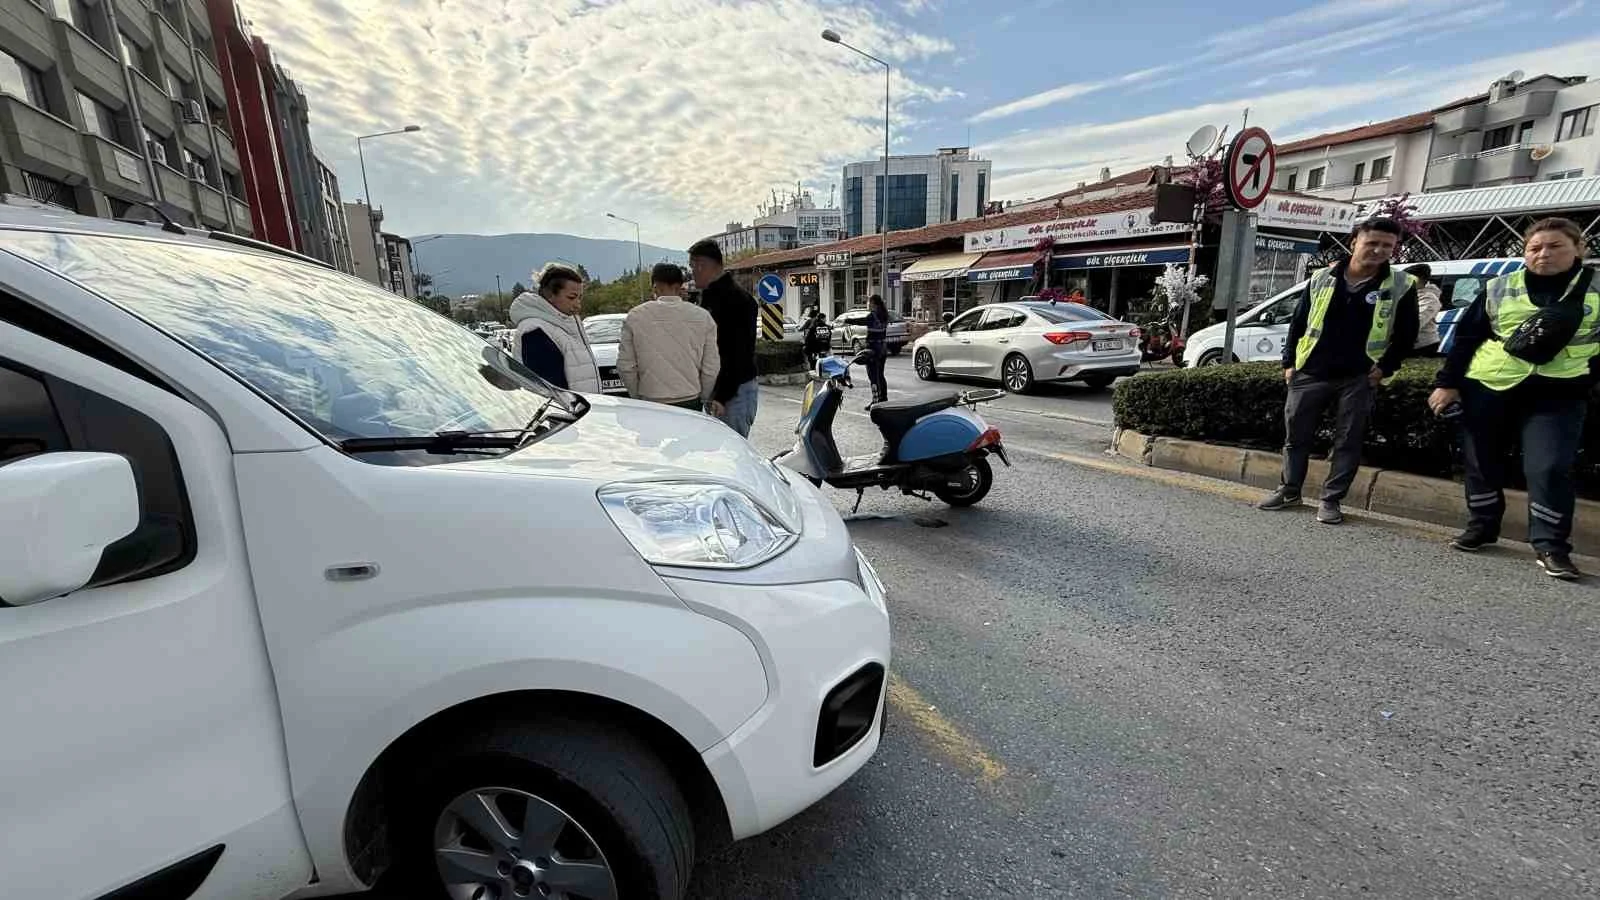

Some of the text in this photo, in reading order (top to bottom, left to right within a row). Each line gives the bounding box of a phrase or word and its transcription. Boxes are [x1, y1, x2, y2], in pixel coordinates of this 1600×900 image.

[1028, 224, 1044, 234] GÜL
[1086, 254, 1148, 265] GÜL ÇİÇEKÇİLİK
